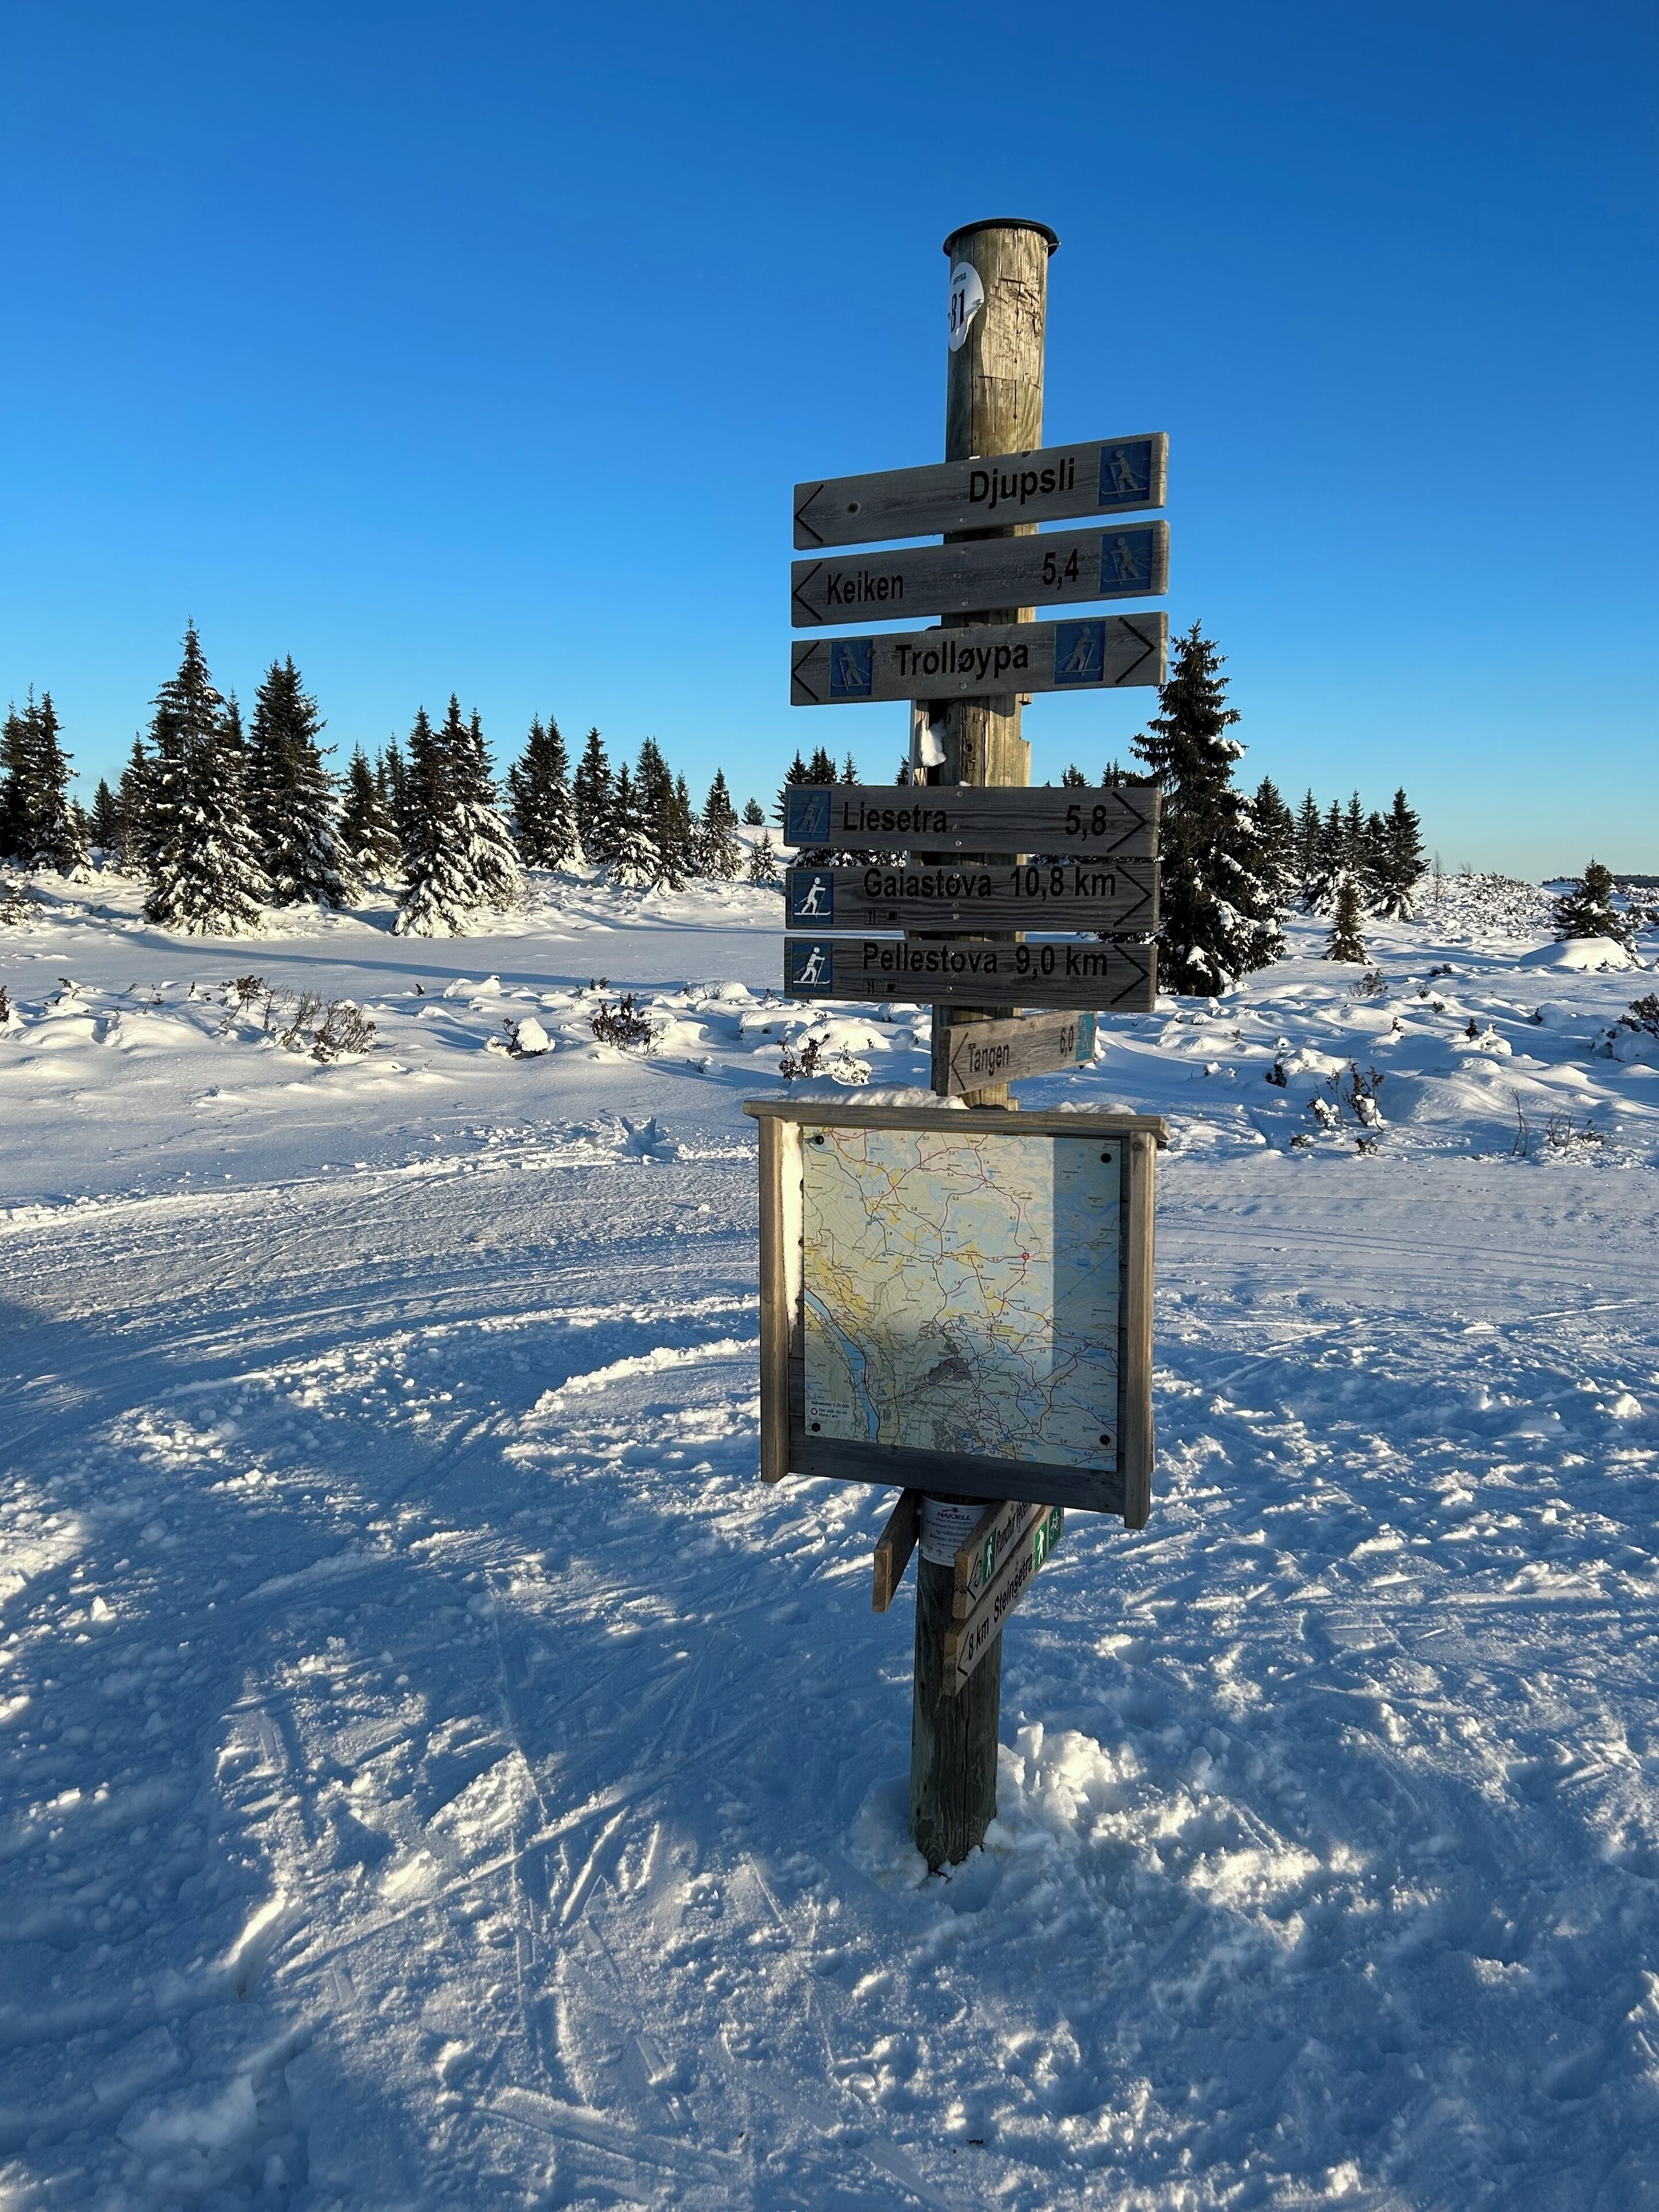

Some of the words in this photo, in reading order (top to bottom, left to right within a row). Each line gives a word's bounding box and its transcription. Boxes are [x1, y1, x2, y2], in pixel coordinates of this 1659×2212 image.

[950, 289, 965, 332] 81
[969, 458, 1075, 509] Djupsli
[827, 570, 904, 607] Keiken
[1041, 549, 1080, 593] 5,4
[895, 641, 1029, 680] Trolløypa
[843, 801, 948, 834] Liesetra
[1065, 804, 1107, 842] 5,8
[864, 867, 991, 898] Gaiastova
[1010, 866, 1065, 902] 10,8
[1074, 868, 1116, 897] km
[863, 942, 998, 974] Pellestova
[1014, 944, 1055, 980] 9,0
[1066, 945, 1108, 976] km
[968, 1043, 1009, 1077] Tangen
[1059, 1025, 1074, 1058] 6,0
[937, 1512, 972, 1520] HAFJELL
[968, 1633, 974, 1661] 8
[976, 1616, 989, 1650] km
[994, 1553, 1033, 1623] Steinsetra
